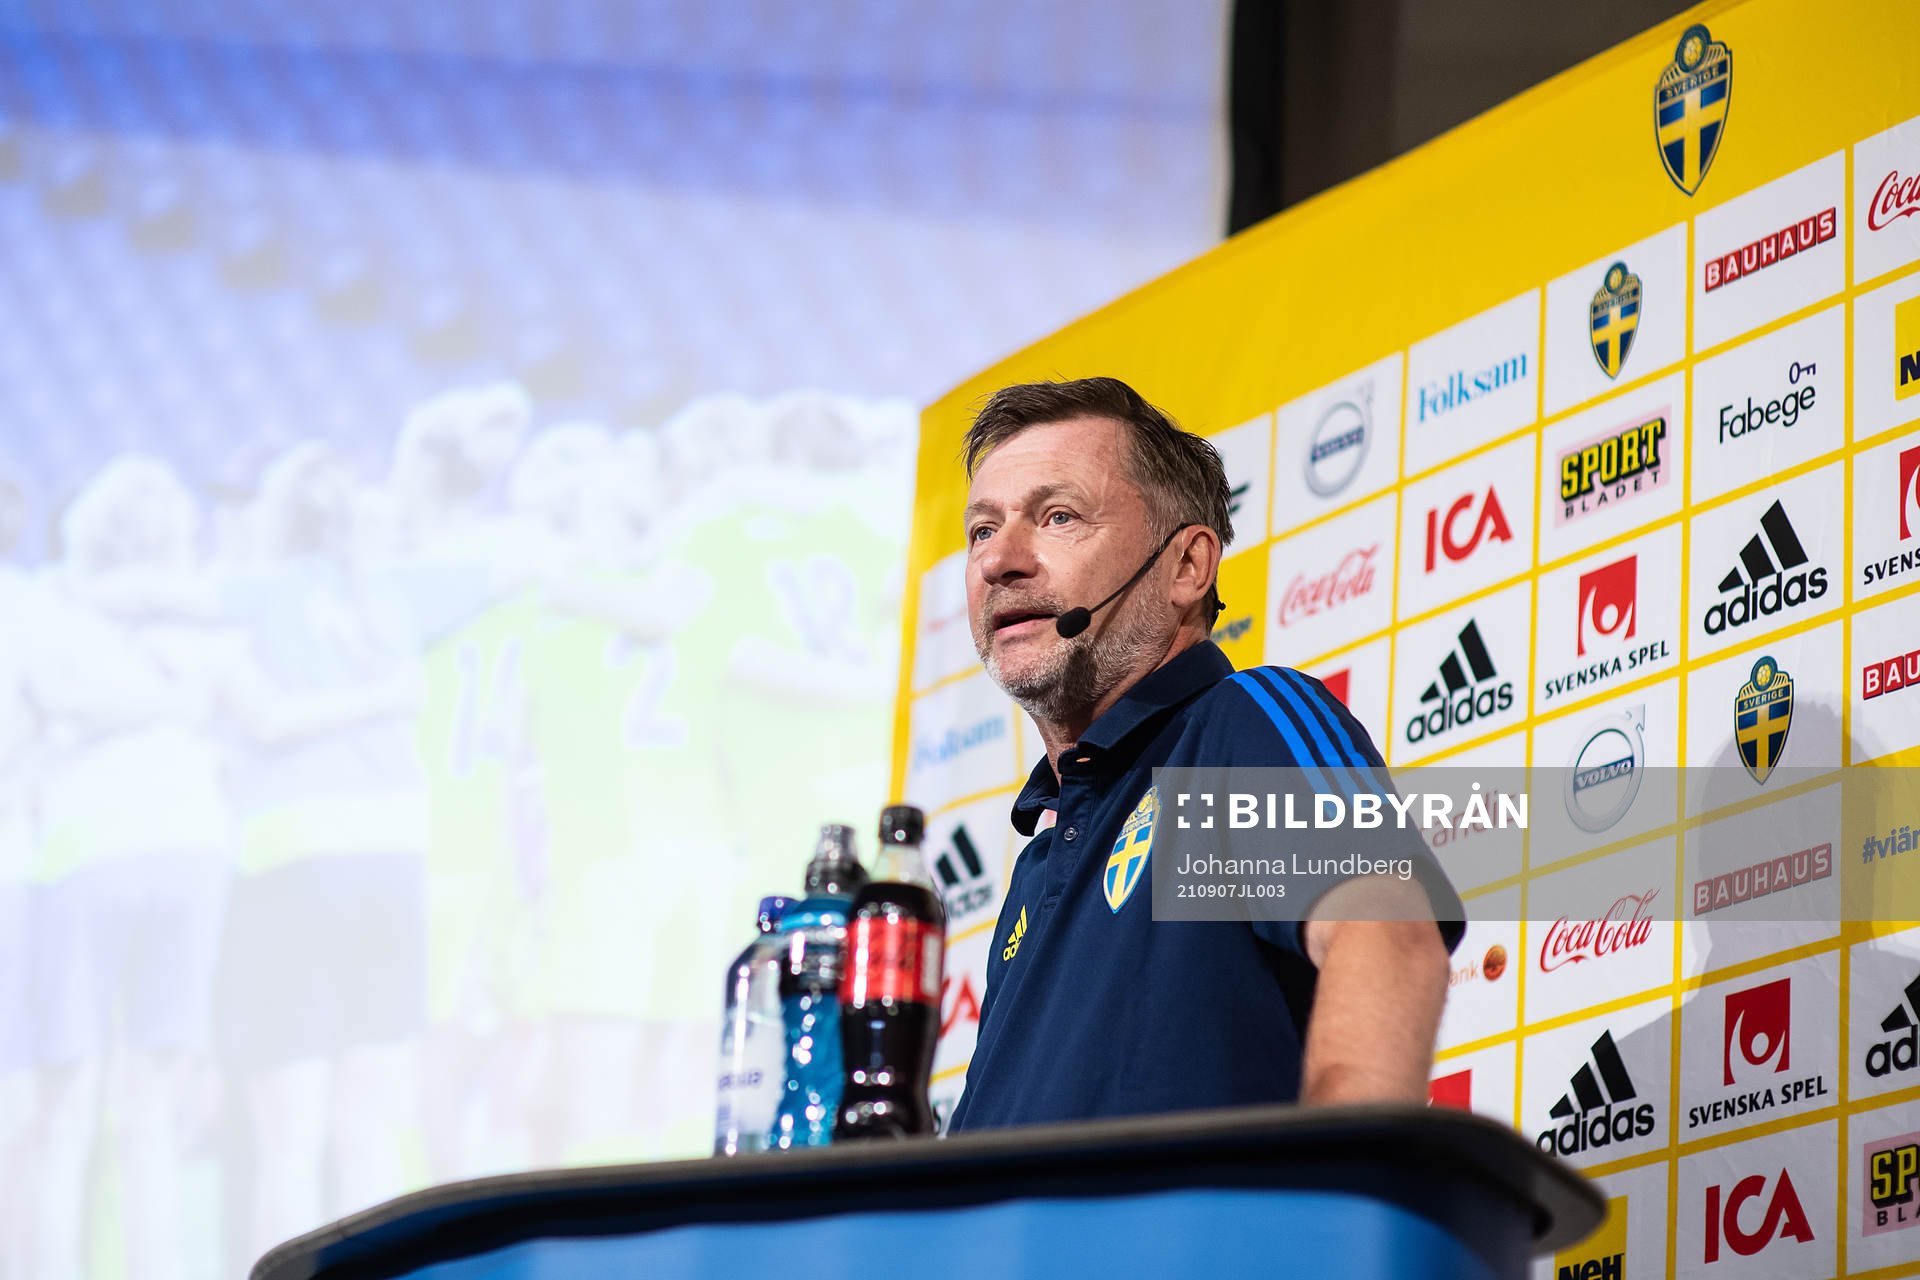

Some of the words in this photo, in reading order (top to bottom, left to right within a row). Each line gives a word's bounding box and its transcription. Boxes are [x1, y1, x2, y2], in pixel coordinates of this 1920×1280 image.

[1707, 210, 1834, 288] BAUHAUS
[1418, 353, 1528, 424] Folksam
[1719, 386, 1816, 444] Fabege
[1561, 417, 1666, 502] SPORT
[1565, 470, 1660, 519] BLADET
[1424, 482, 1513, 574] ICA
[1704, 566, 1828, 635] adidas
[1545, 657, 1623, 699] SVENSKA
[1628, 639, 1670, 670] SPEL
[1743, 688, 1784, 710] SVERIGE
[1406, 681, 1513, 744] adidas
[1576, 759, 1632, 788] VOLVO
[1695, 848, 1830, 911] BAUHAUS
[1537, 1104, 1655, 1157] adidas
[1689, 1094, 1774, 1128] SVENSKA
[1781, 1076, 1828, 1109] SPEL
[1704, 1167, 1815, 1265] ICA
